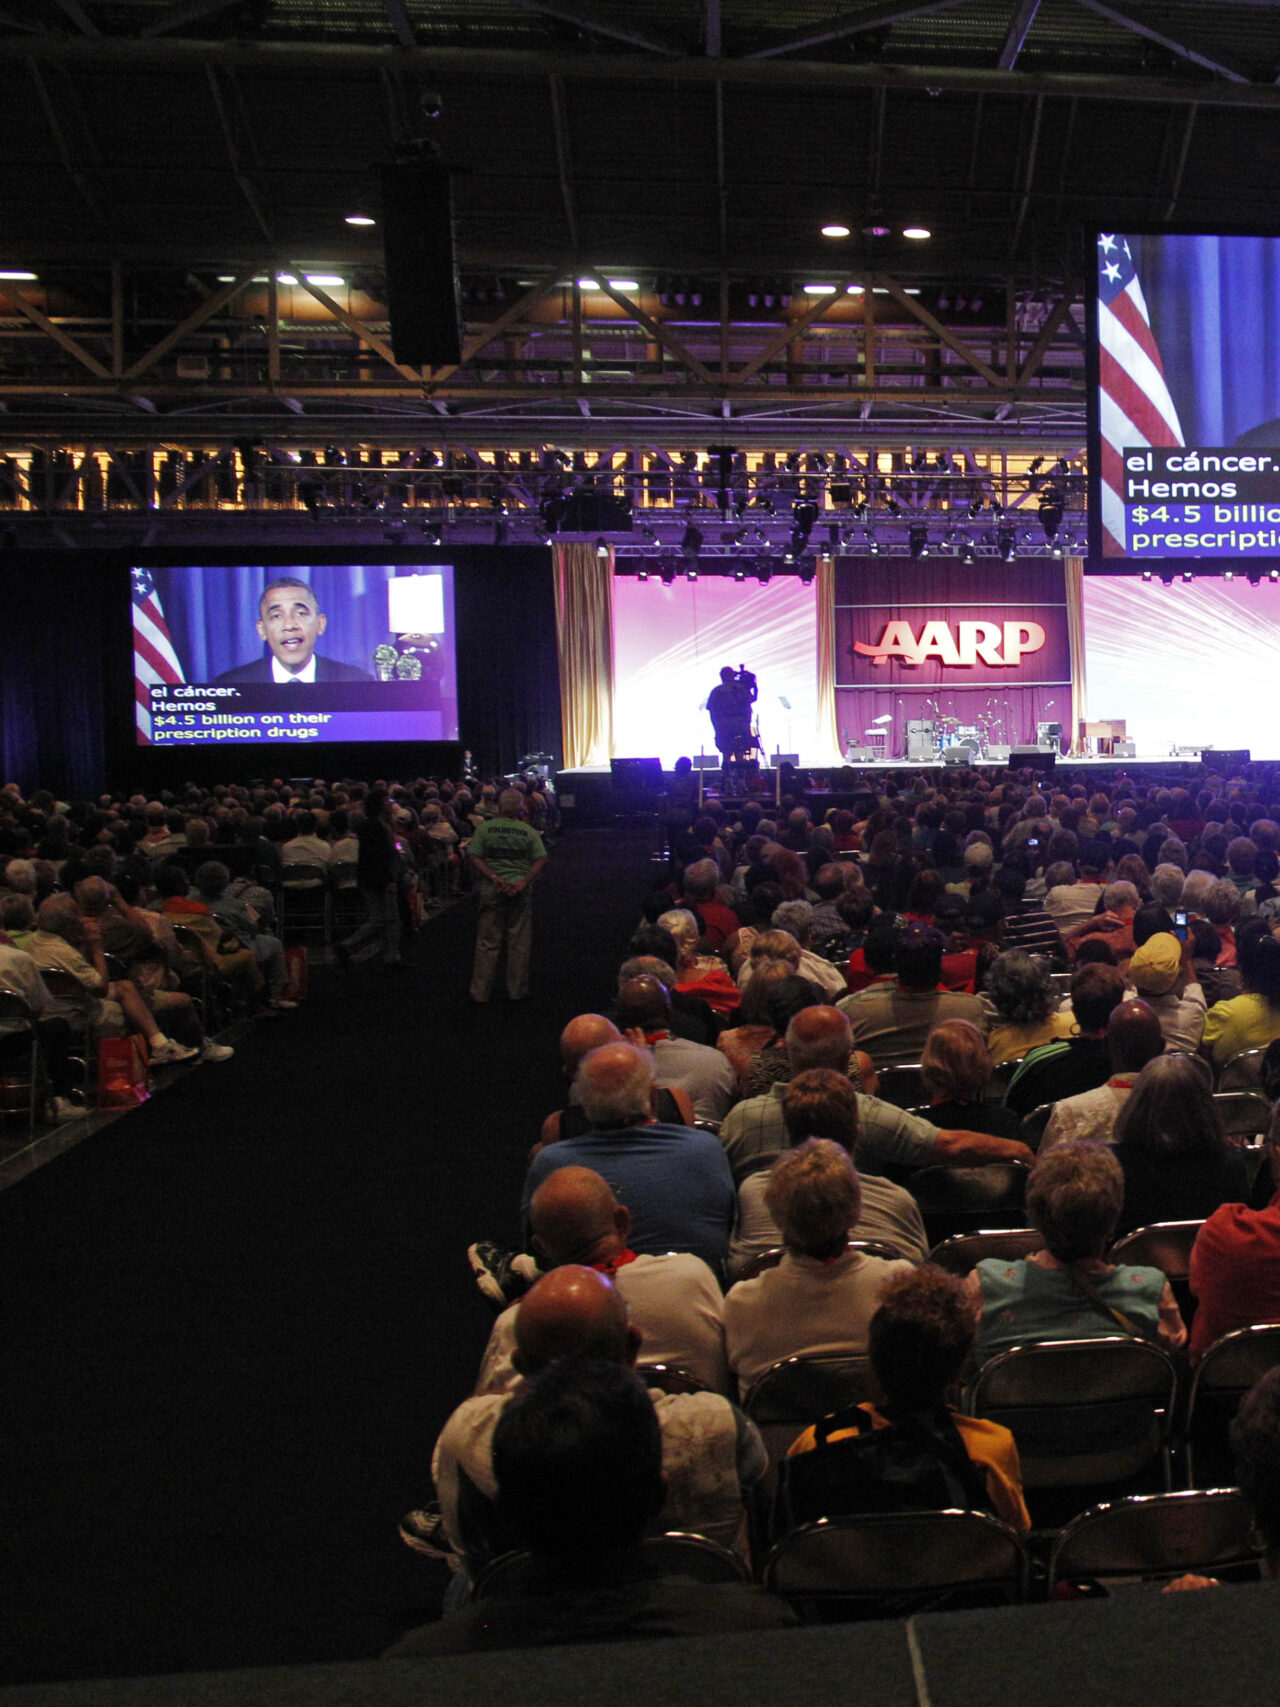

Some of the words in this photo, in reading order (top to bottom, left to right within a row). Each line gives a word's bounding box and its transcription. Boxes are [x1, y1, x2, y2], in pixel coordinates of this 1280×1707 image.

[1126, 452, 1153, 472] el
[1165, 451, 1280, 472] cáncer.
[1128, 478, 1238, 498] Hemos
[1131, 505, 1201, 526] $4.5
[853, 620, 1046, 665] AARP
[150, 686, 167, 698] el
[173, 685, 241, 698] cáncer.
[151, 700, 217, 712] Hemos
[154, 714, 196, 728] $4.5
[201, 713, 255, 726] billion
[260, 715, 284, 724] on
[288, 712, 333, 724] their
[154, 727, 262, 742] prescription
[266, 726, 320, 740] drugs
